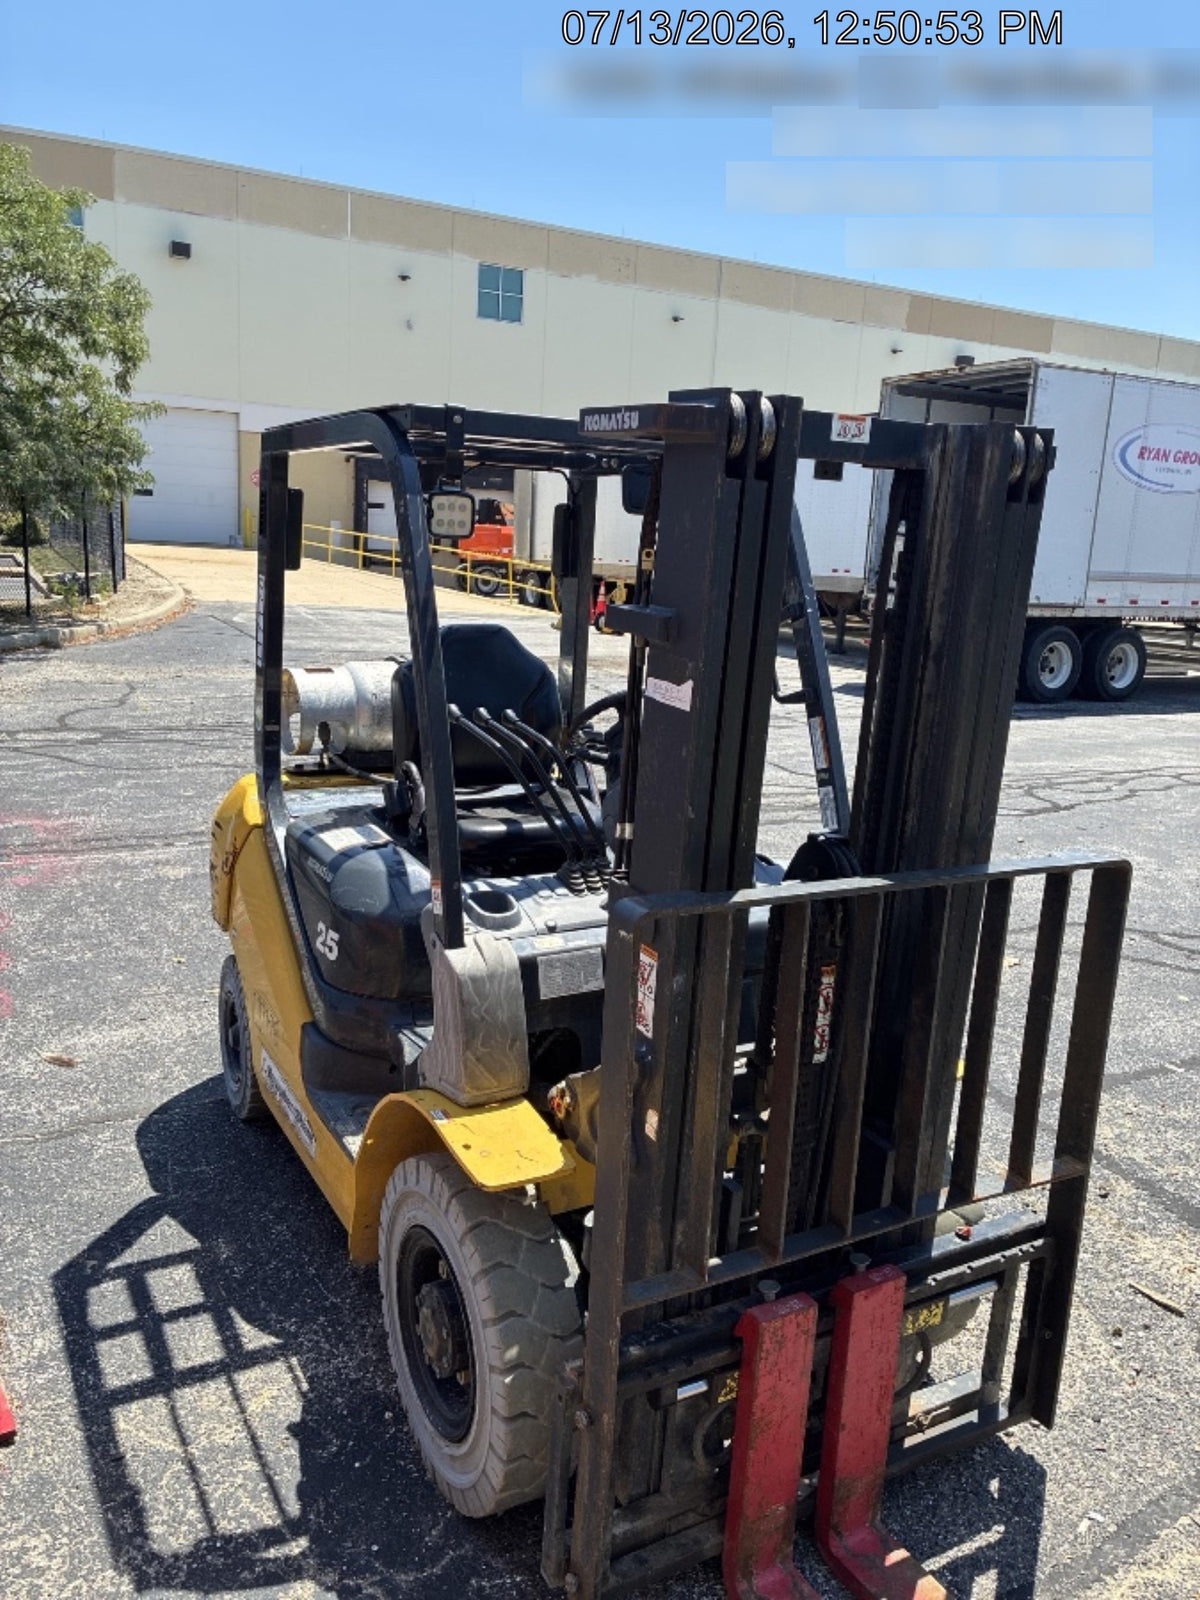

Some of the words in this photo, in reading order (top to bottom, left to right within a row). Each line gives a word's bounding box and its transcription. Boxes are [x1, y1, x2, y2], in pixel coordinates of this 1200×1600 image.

[584, 408, 640, 431] KOMATSU
[1137, 446, 1171, 462] RYAN
[1173, 450, 1200, 466] GRO
[316, 920, 340, 961] 25
